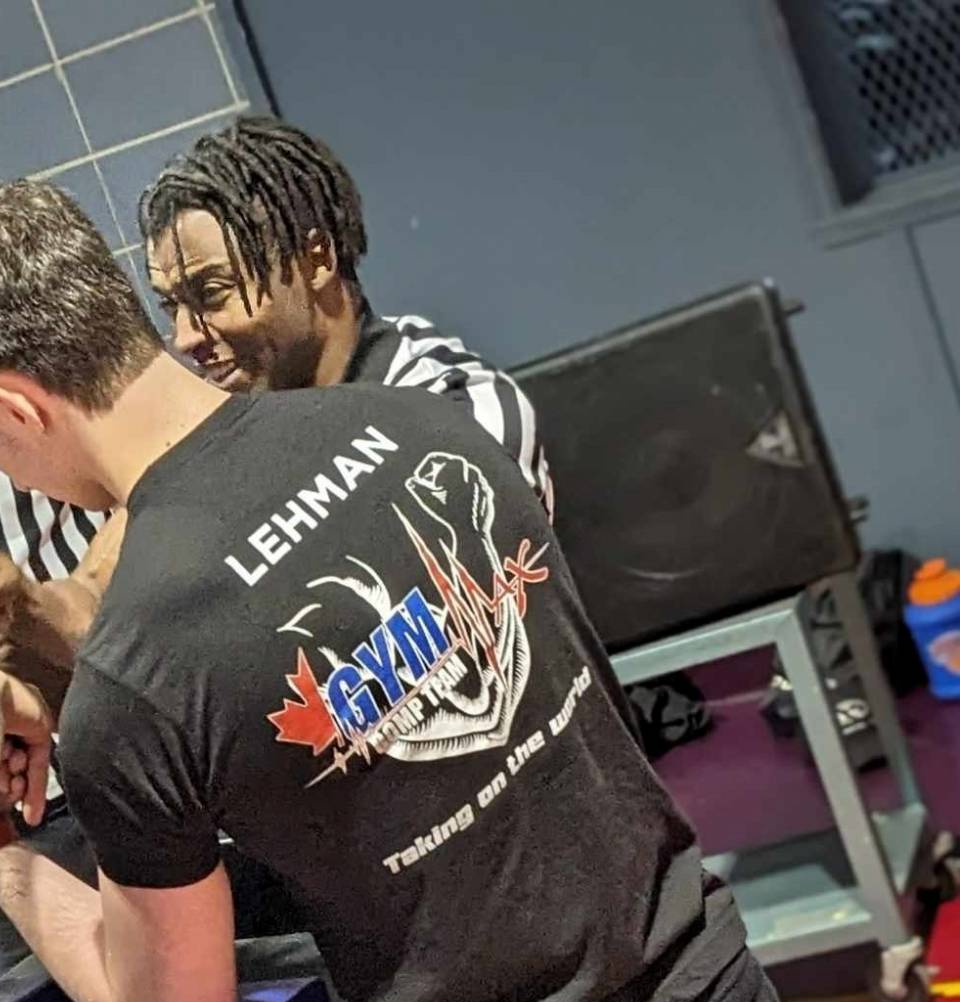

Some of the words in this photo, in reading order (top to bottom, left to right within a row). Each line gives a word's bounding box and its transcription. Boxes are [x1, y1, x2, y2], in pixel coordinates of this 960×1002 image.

[224, 425, 400, 587] LEHMAN
[325, 586, 452, 735] GYM
[420, 653, 468, 706] TEAM
[383, 803, 474, 875] Taking
[476, 772, 508, 810] on
[506, 730, 546, 777] the
[548, 665, 593, 737] world
